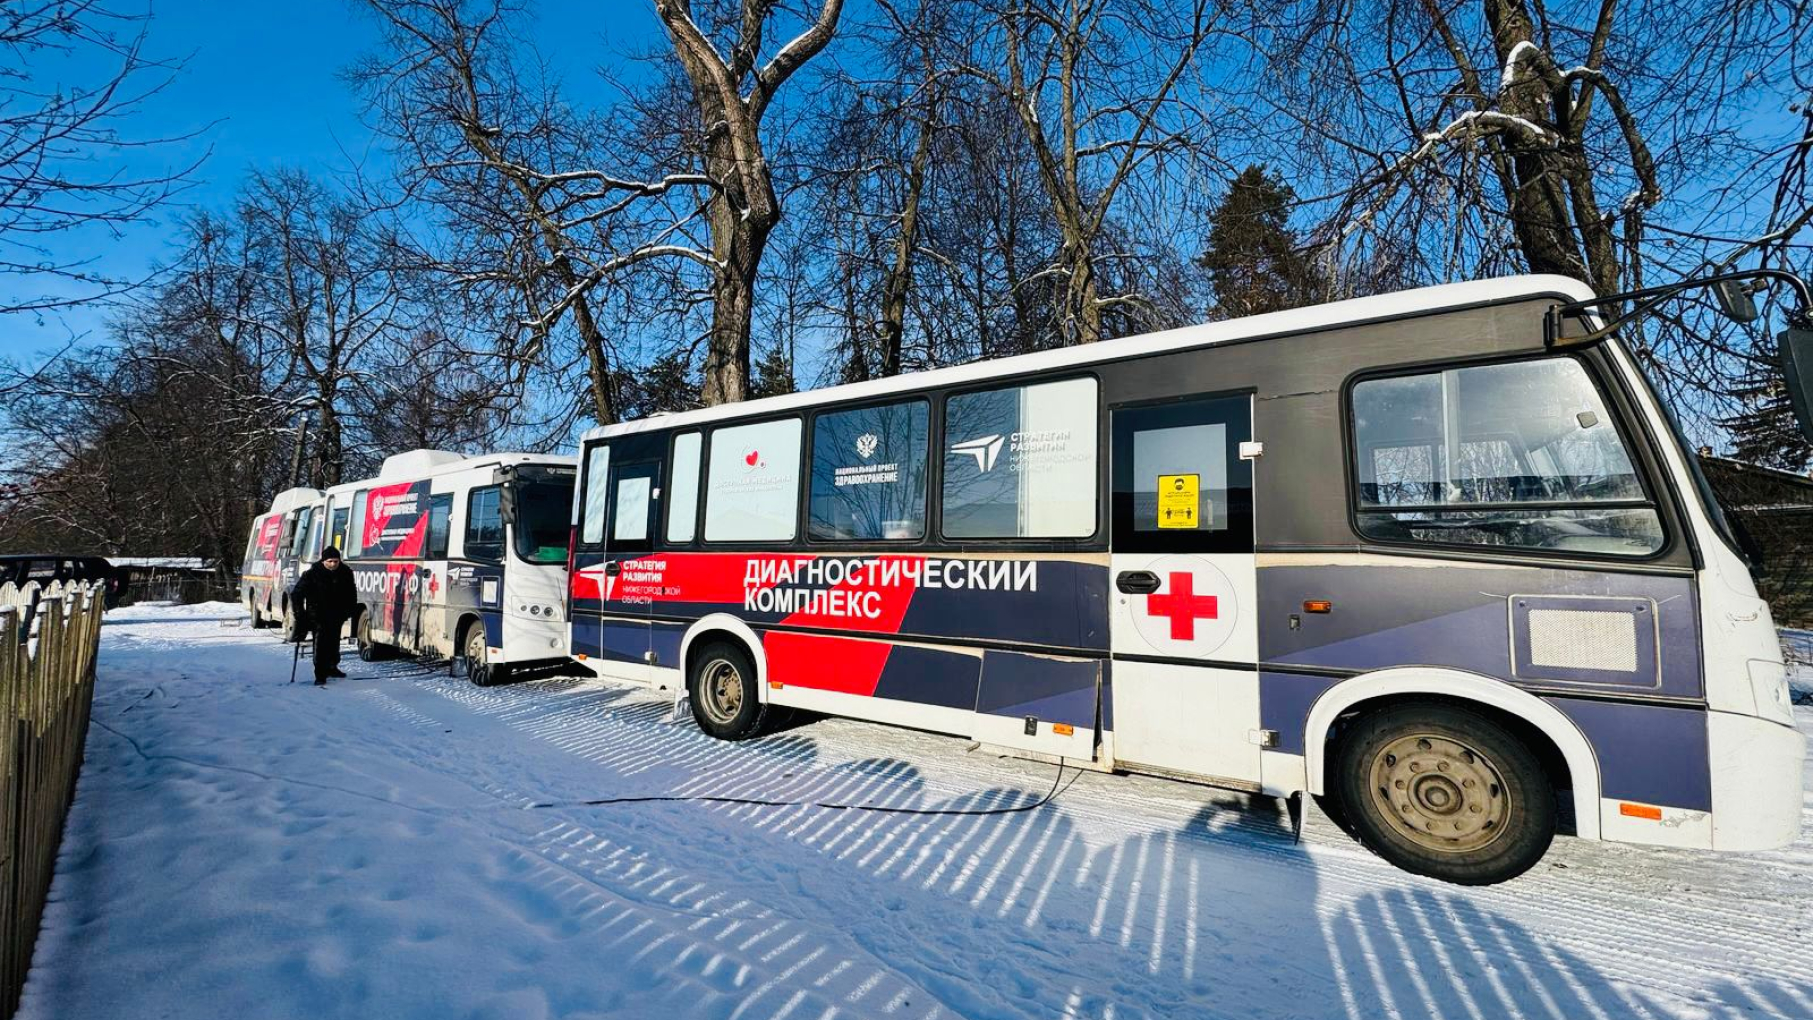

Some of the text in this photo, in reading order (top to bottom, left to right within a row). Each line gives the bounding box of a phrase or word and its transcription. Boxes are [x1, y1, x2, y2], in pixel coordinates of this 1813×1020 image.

[834, 471, 898, 486] ЗДРАВООХРАНЕНИЕ
[623, 560, 667, 570] СТРАТЕГИЯ
[622, 571, 663, 582] РАЗВИТИЯ
[353, 570, 419, 595] ЮОРОГРАФ
[622, 585, 681, 596] НИЖЕГОРОДКОЙ
[622, 595, 652, 605] ОБЛАСТИ
[744, 587, 882, 619] КОМПЛЕКС
